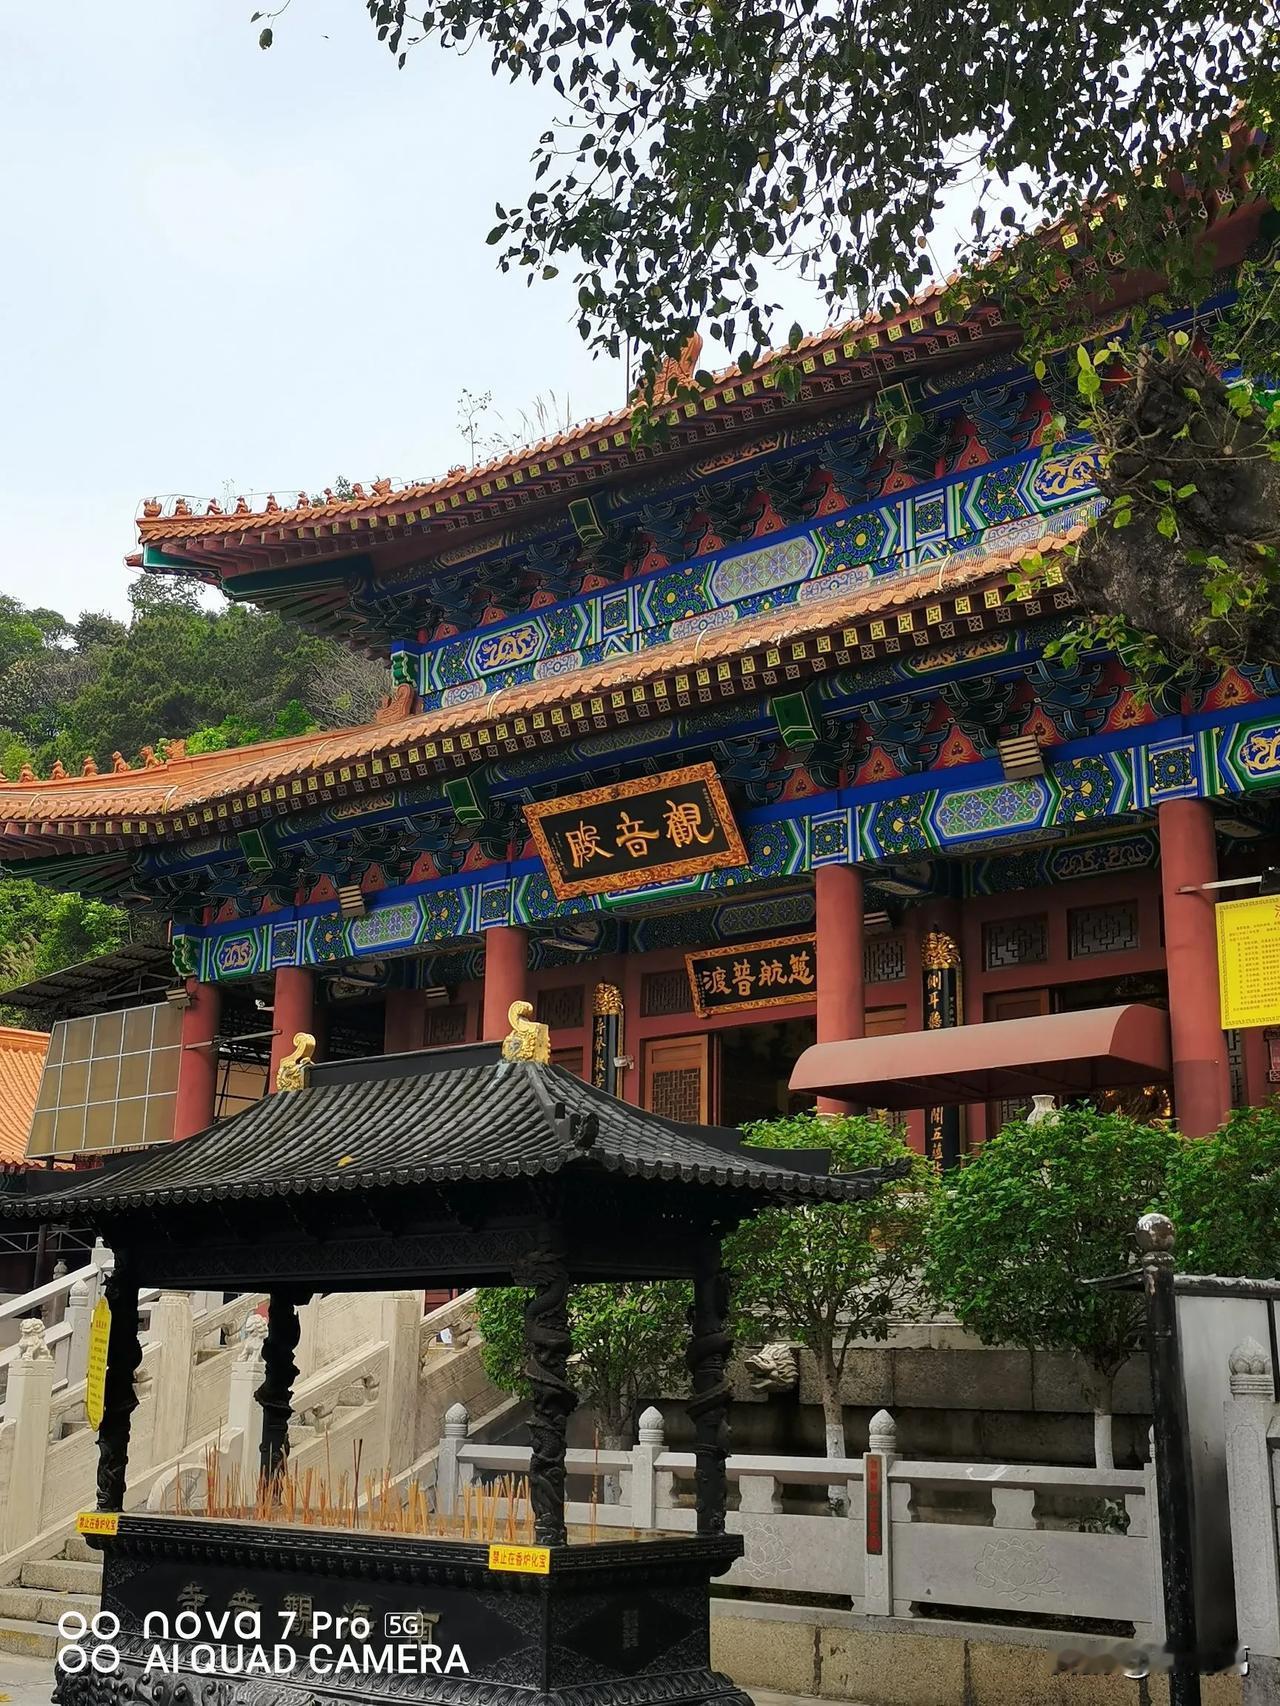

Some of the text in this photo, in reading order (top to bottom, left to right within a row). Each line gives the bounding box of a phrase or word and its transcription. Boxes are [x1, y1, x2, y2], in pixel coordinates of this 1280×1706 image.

[492, 1550, 547, 1569] 禁止在香炉化宝
